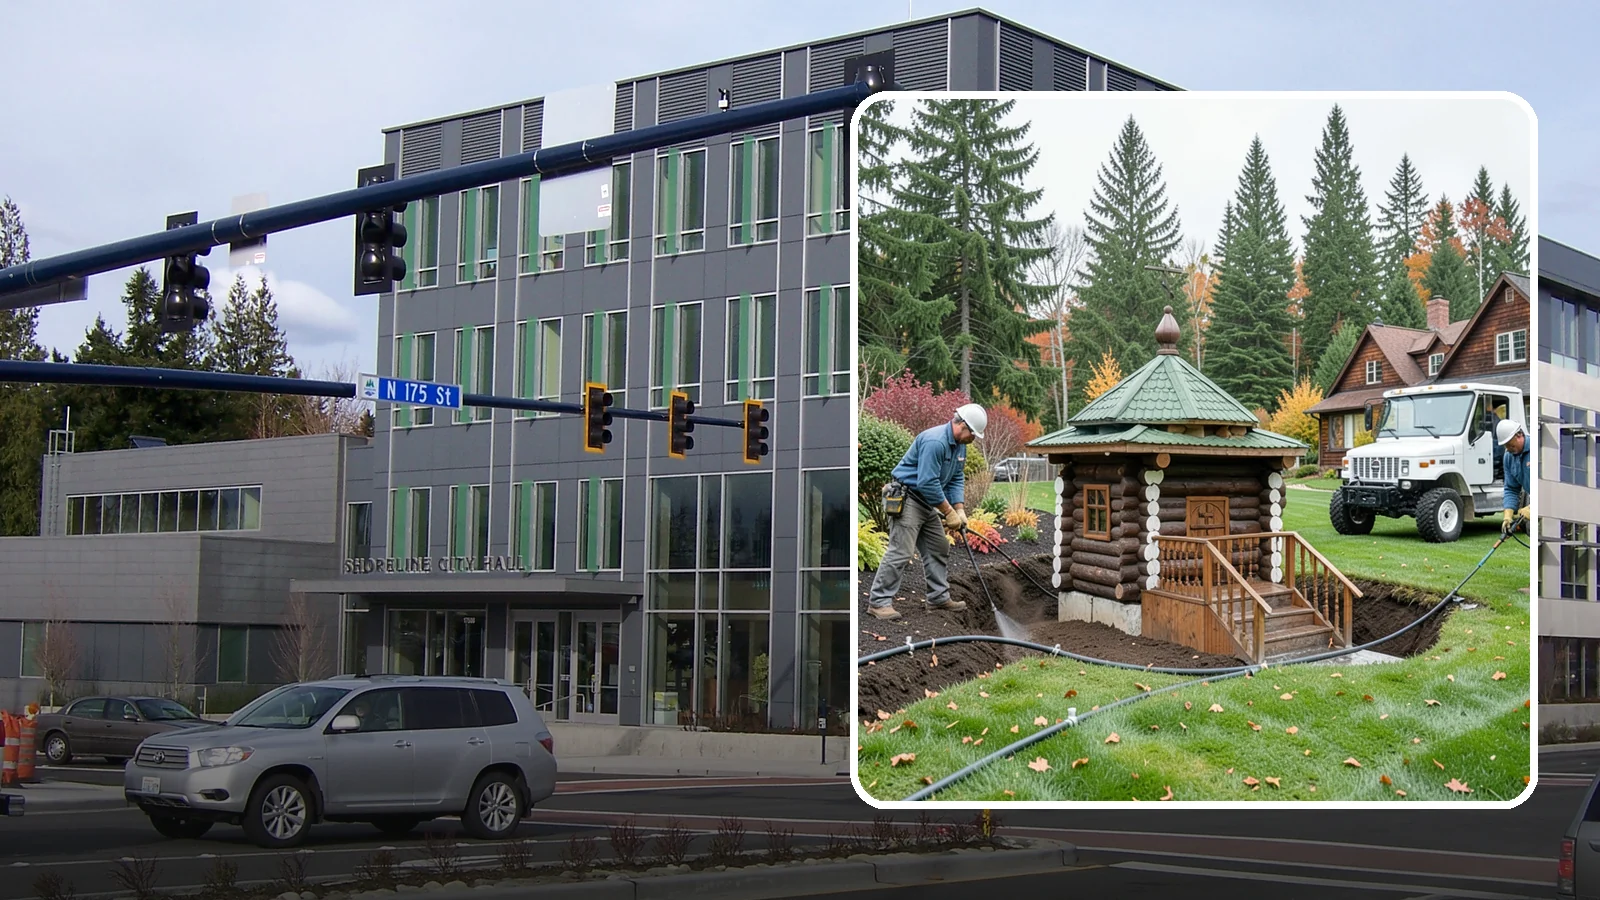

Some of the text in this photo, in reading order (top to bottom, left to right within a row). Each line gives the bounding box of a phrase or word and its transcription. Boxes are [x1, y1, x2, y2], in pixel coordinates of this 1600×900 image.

[387, 381, 451, 406] N 175 St
[343, 555, 525, 574] SHORELINE CITY HALL
